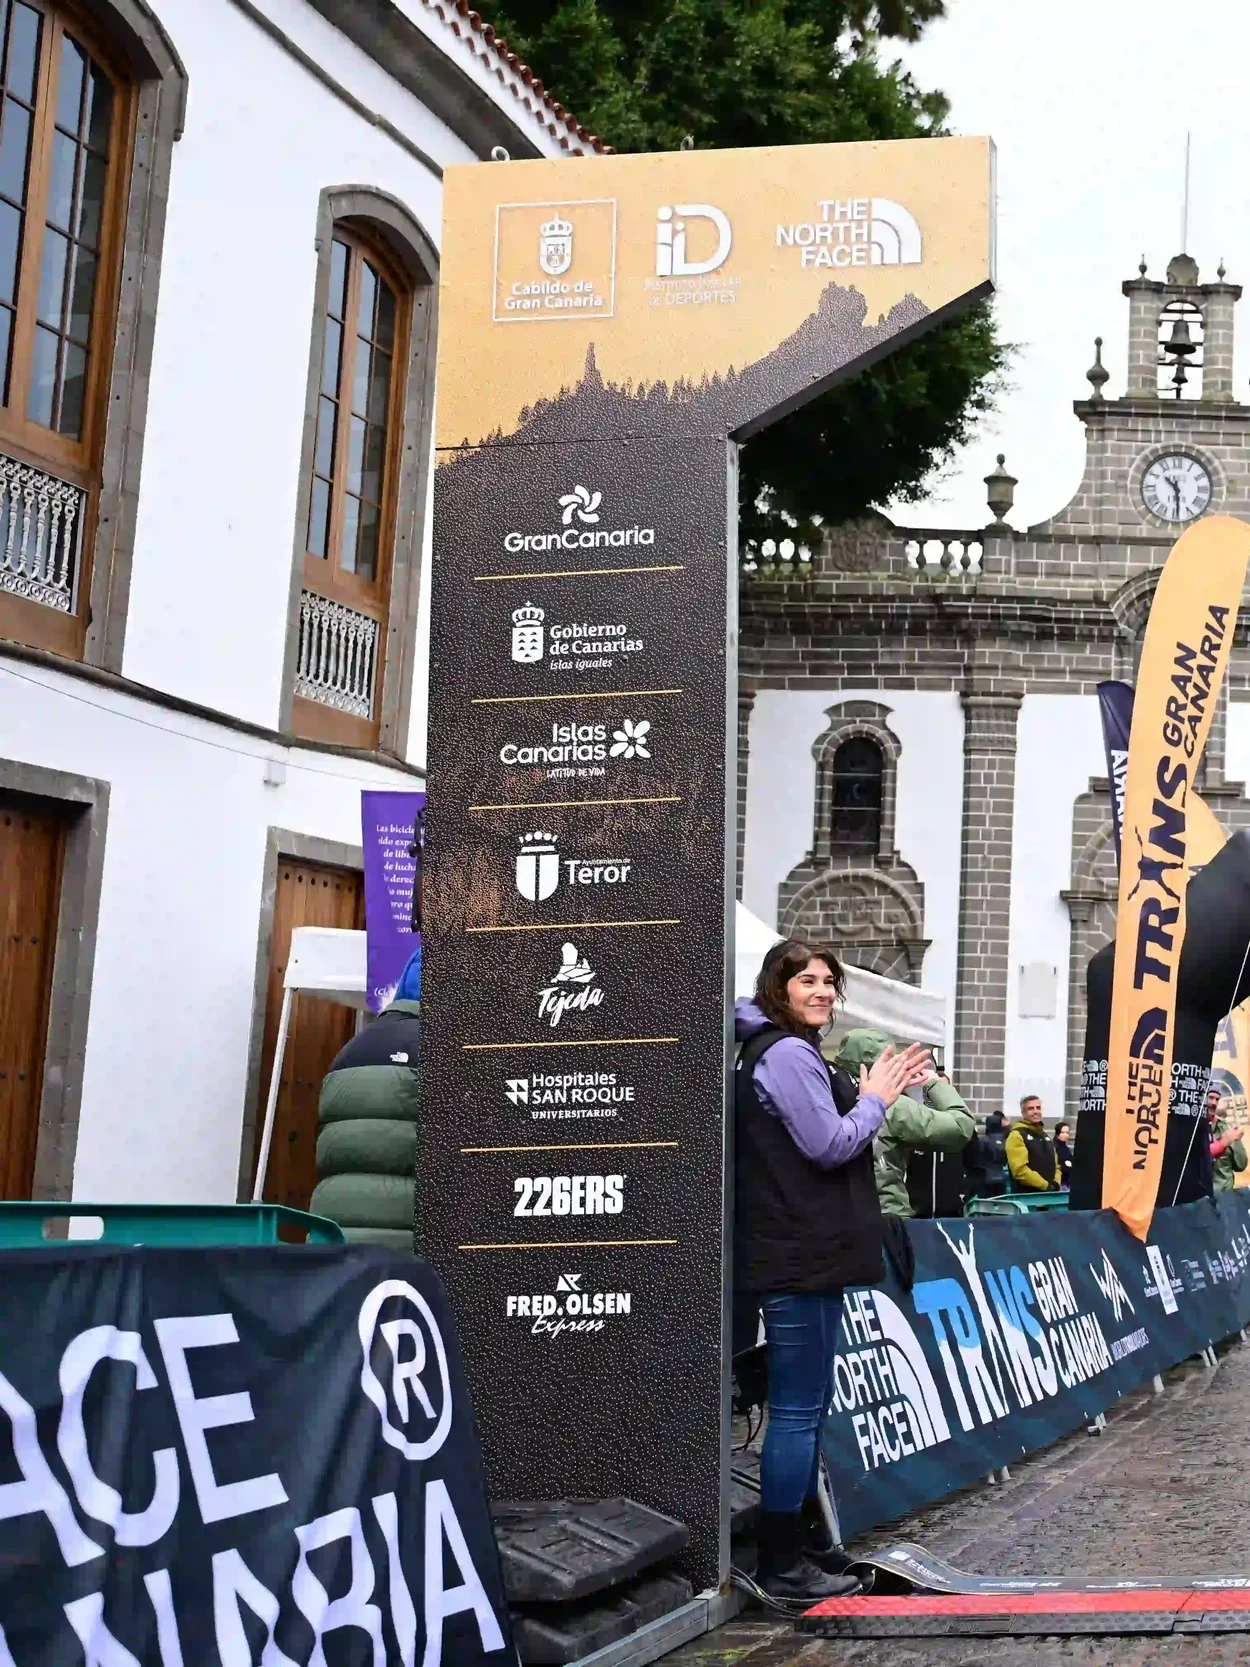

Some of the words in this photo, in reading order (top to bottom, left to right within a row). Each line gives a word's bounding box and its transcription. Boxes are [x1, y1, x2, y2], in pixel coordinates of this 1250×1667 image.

[817, 198, 868, 222] THE
[776, 221, 869, 247] NORTH
[801, 244, 868, 268] FACE
[511, 281, 570, 296] Cabildo
[574, 280, 593, 293] de
[664, 290, 736, 306] DEPORTES
[504, 296, 541, 311] Gran
[545, 293, 603, 309] Canaria
[504, 525, 655, 552] GranCanaria
[550, 623, 627, 639] Gobierno
[549, 642, 570, 656] de
[572, 639, 644, 655] Canarias
[550, 660, 574, 670] islas
[575, 658, 613, 671] iguales
[1184, 604, 1231, 759] CANARIA
[1163, 641, 1199, 748] GRAN
[552, 723, 607, 743] Islas
[500, 741, 607, 765] Canarias
[564, 860, 631, 884] Teror
[537, 985, 605, 1027] Tejeda
[1088, 1073, 1107, 1085] THE
[1172, 1062, 1202, 1075] ORTH
[532, 1071, 617, 1091] Hospitales
[532, 1088, 567, 1105] SAN
[571, 1086, 635, 1104] ROQUE
[1180, 1089, 1198, 1104] THE
[532, 1109, 617, 1120] UNIVERSITARIOS
[514, 1174, 624, 1217] 226ERS
[1027, 1256, 1079, 1324] GRAN
[531, 1313, 606, 1339] Express
[1050, 1312, 1114, 1389] CANARIA
[851, 1401, 915, 1471] FACE
